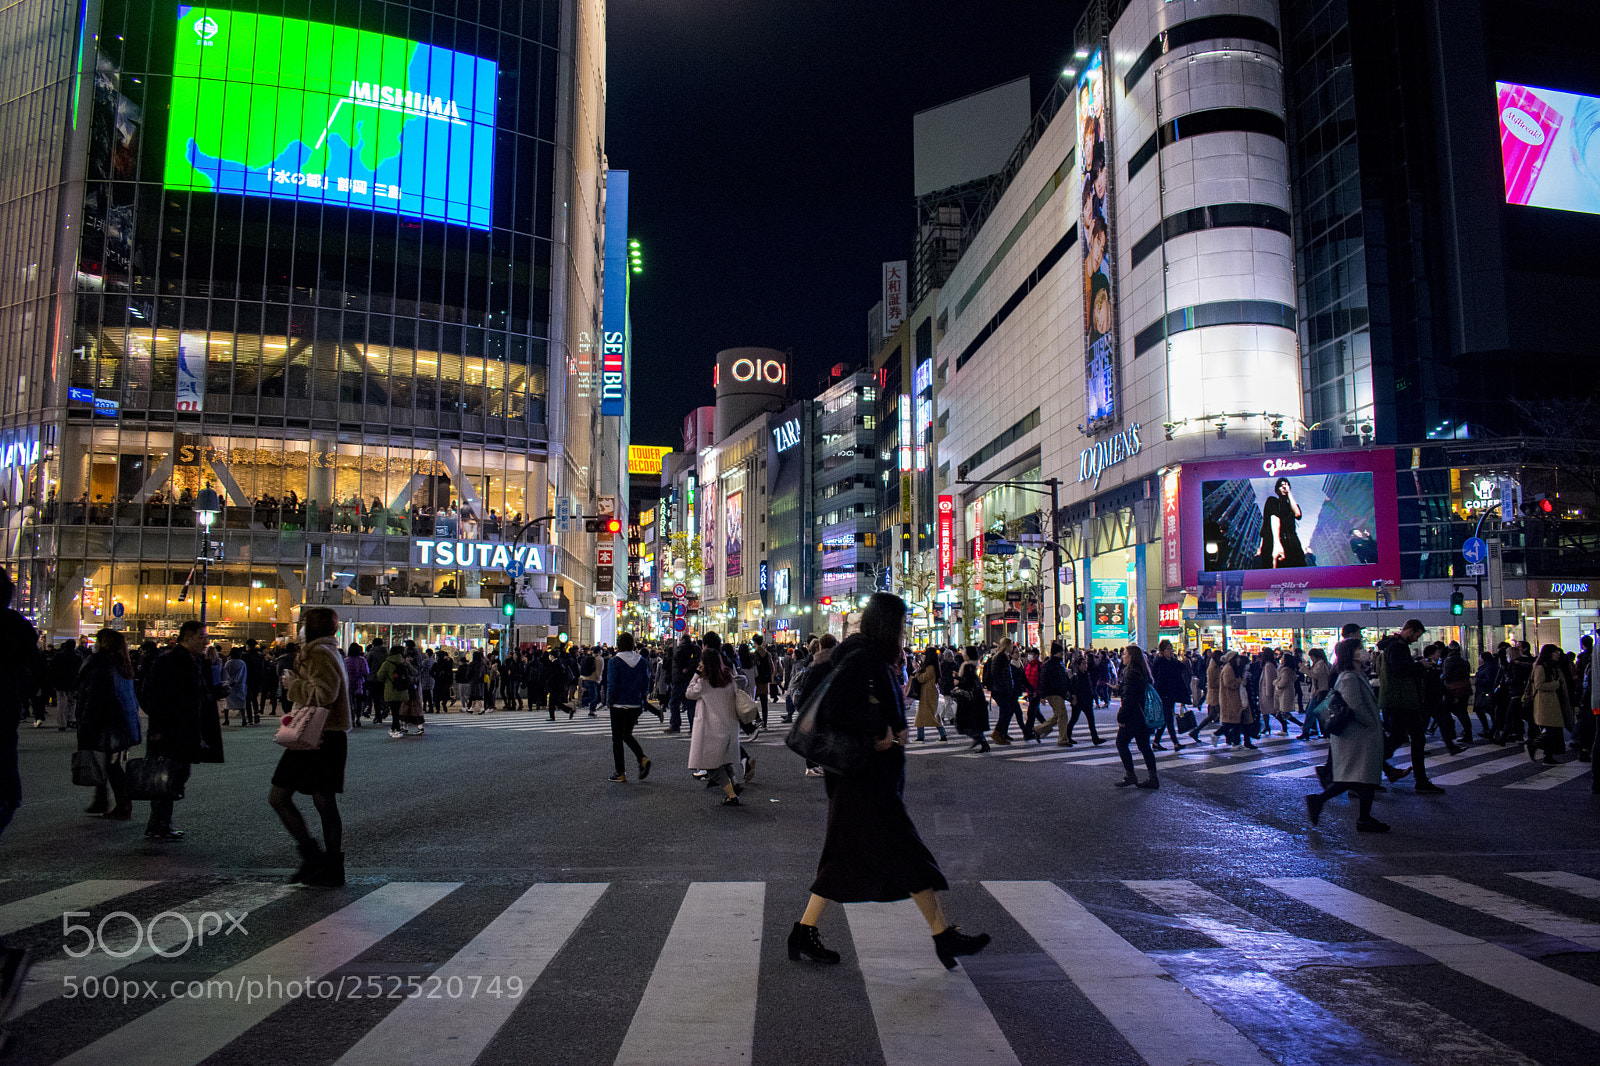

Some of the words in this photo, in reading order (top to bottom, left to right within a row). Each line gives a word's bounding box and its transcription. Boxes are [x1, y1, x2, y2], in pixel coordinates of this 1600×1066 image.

[348, 80, 460, 120] MISHIMA
[888, 266, 902, 320] 大和証券
[603, 331, 623, 399] SEIBU
[772, 417, 801, 453] ZARA
[631, 447, 661, 460] TOWER
[1262, 458, 1307, 477] Glico
[659, 497, 667, 537] KARAOKE
[416, 540, 542, 570] TSUTAYA
[600, 551, 611, 563] 本
